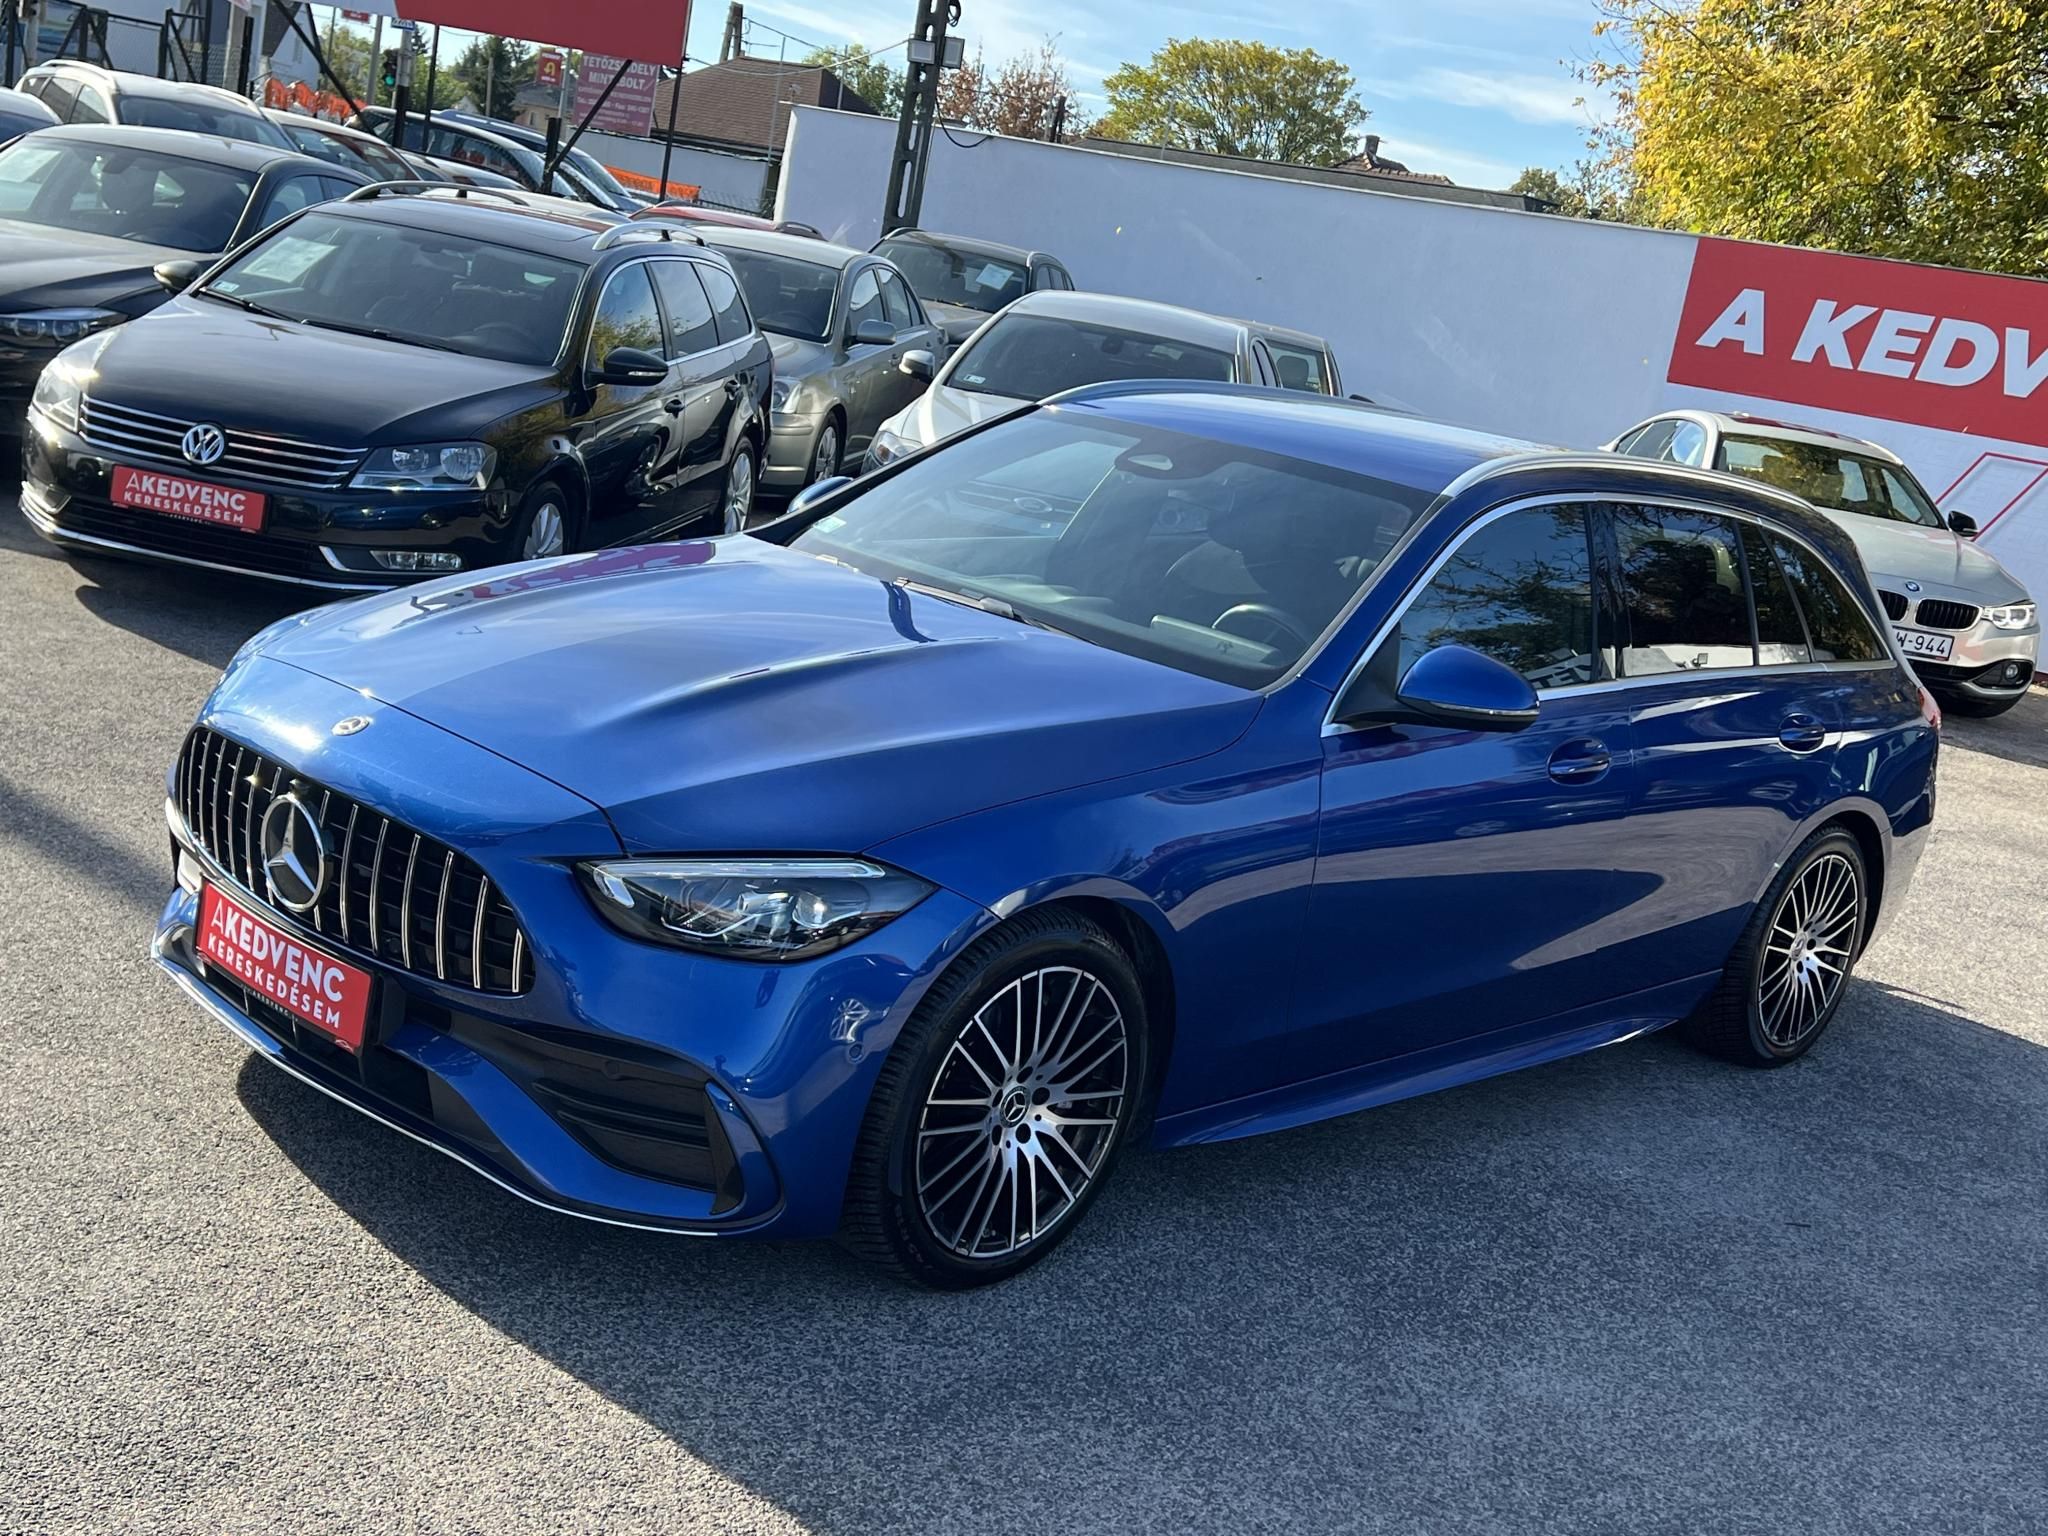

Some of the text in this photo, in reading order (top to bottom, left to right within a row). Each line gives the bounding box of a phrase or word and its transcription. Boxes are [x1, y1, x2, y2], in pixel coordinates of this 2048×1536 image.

[582, 55, 657, 77] TETŐZSDELY
[1695, 288, 1765, 356] A
[123, 490, 245, 525] KERESKEDÉSEM
[125, 471, 247, 512] AKEDVENC
[210, 897, 346, 1003] AKEDVENC
[207, 932, 342, 1030] KERESKEDÉSEM
